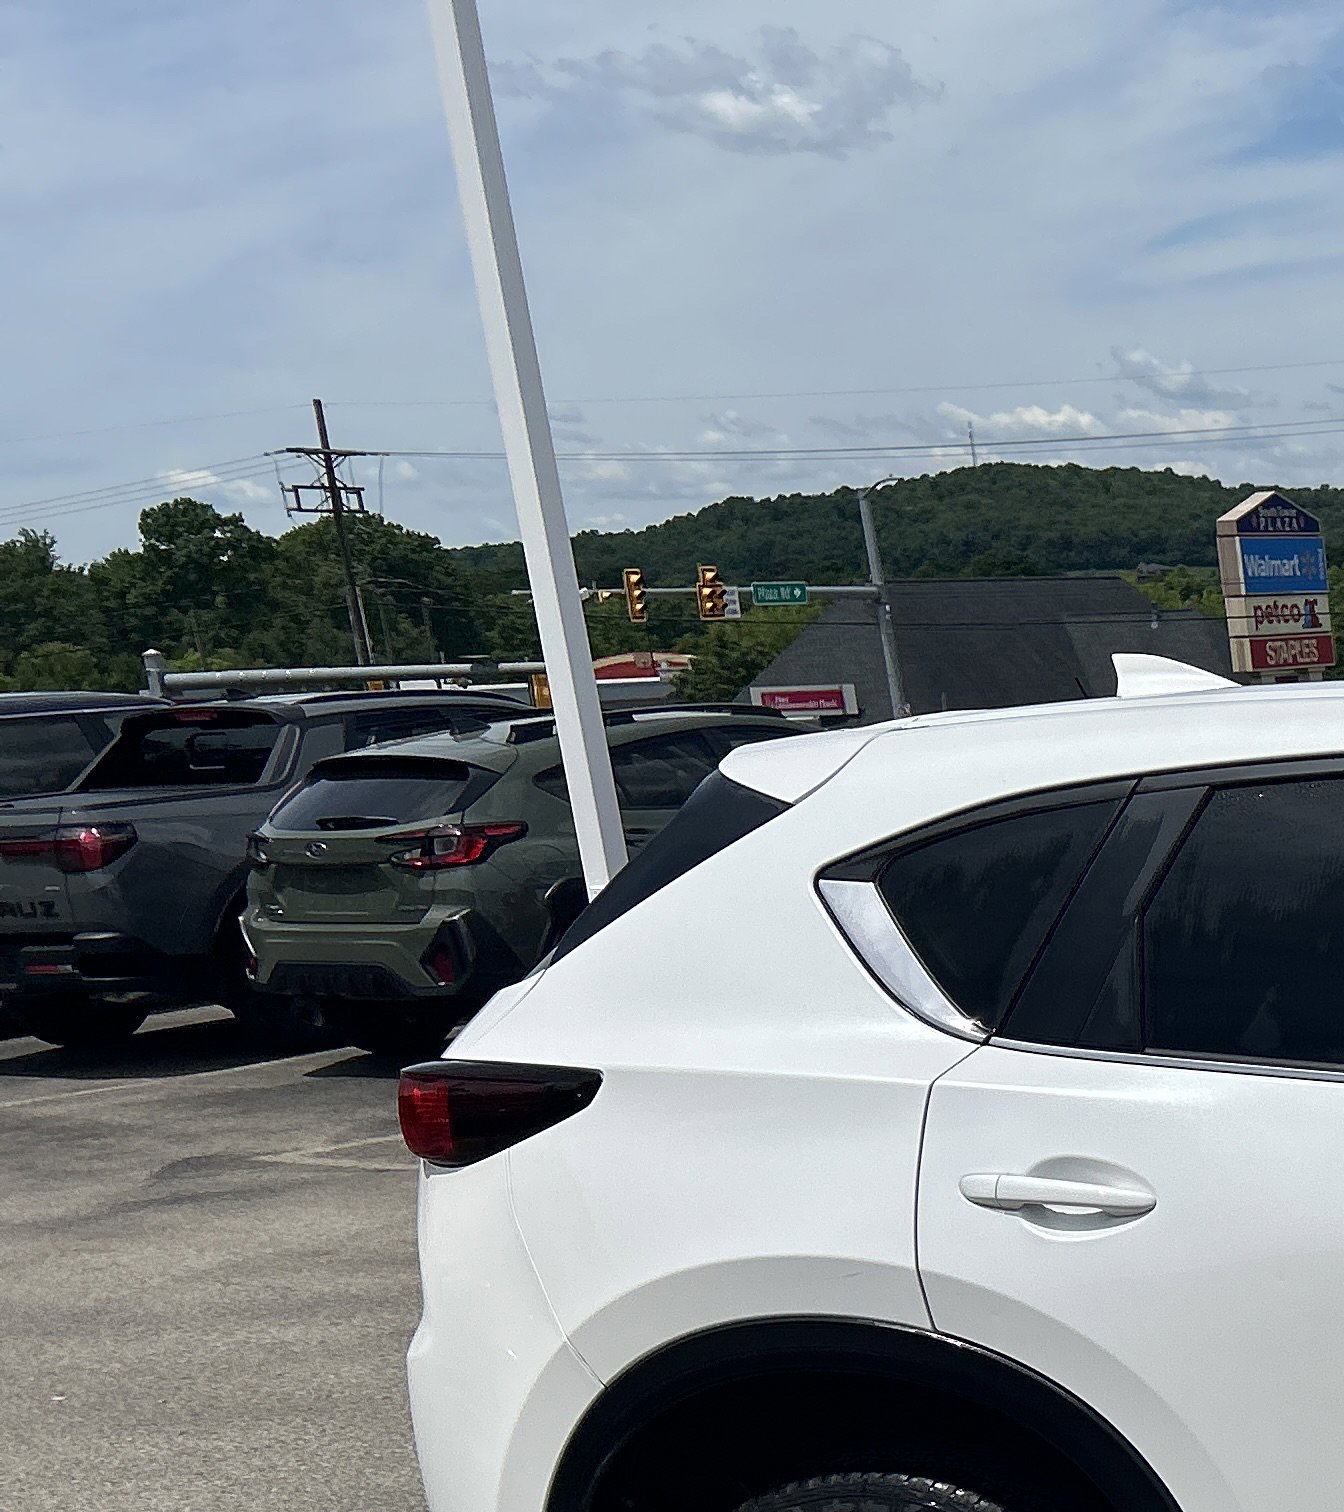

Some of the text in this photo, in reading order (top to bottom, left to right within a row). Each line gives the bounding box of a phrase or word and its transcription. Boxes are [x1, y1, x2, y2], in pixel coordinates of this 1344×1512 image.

[1259, 517, 1299, 531] PLAZA
[1244, 553, 1300, 577] Walmart
[1253, 600, 1301, 631] petco
[1265, 639, 1320, 665] STAPLES
